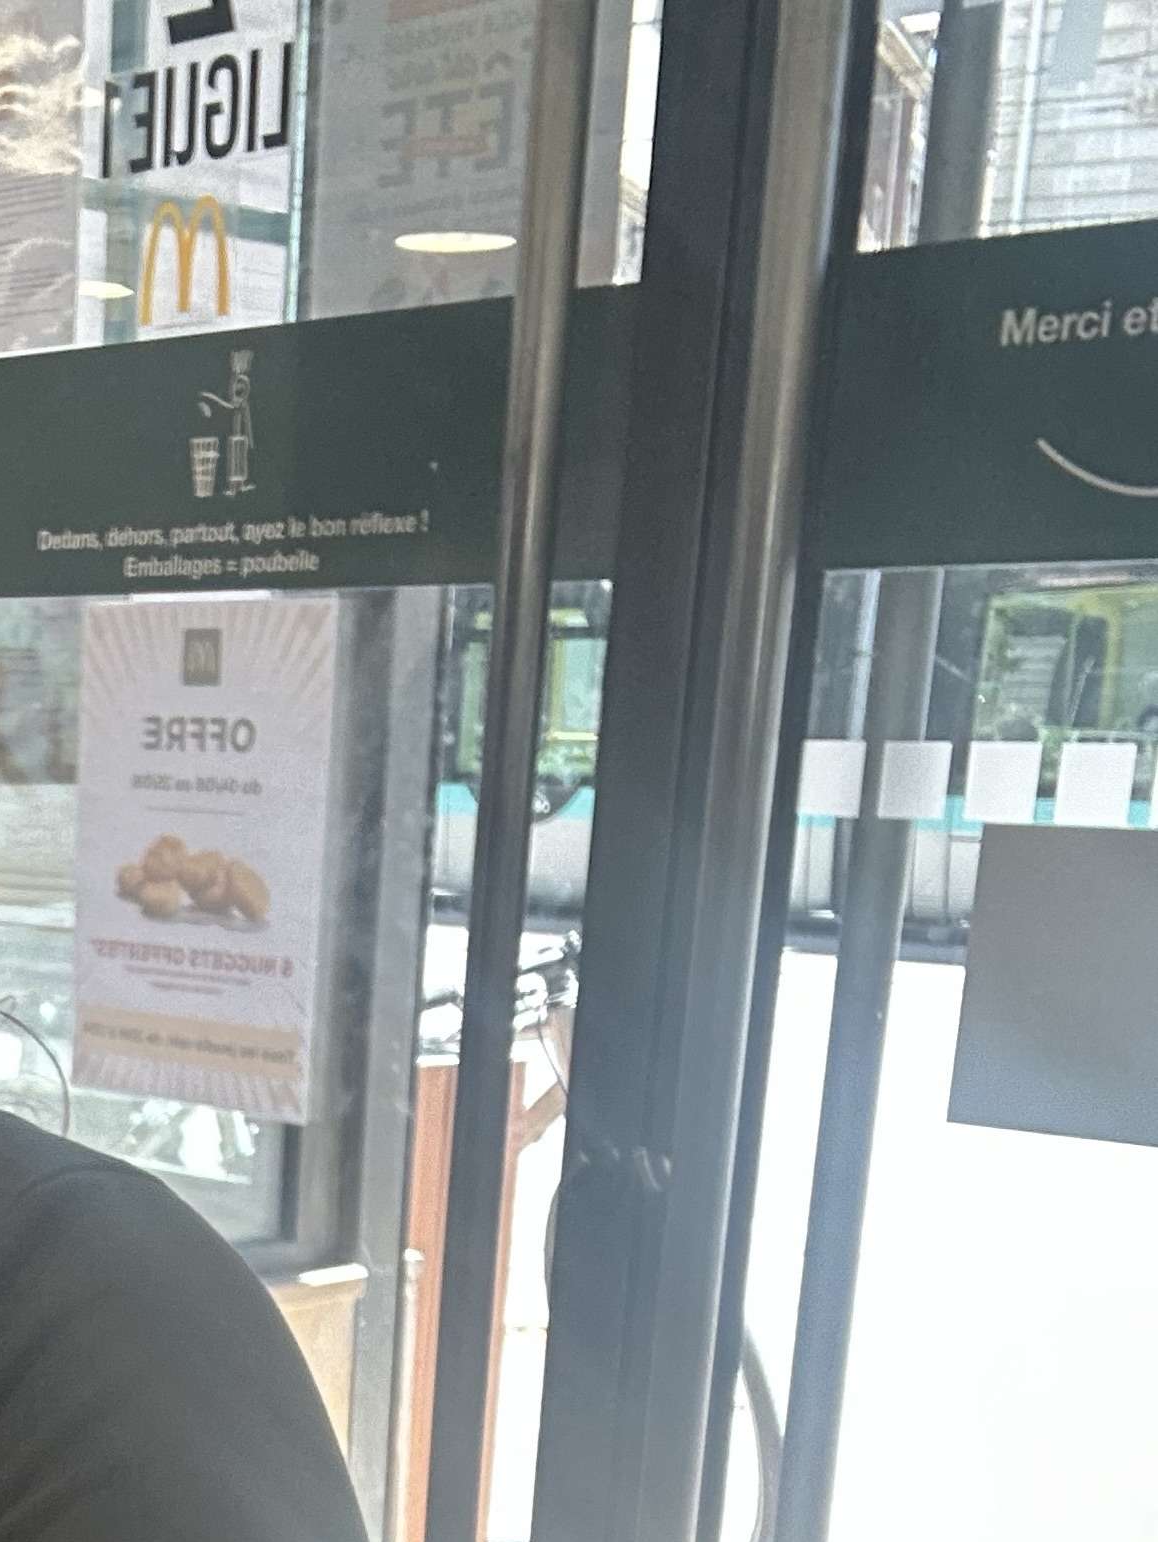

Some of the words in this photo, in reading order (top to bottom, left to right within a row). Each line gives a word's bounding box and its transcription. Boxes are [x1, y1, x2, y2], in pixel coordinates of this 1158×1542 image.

[1001, 300, 1113, 347] Merci
[37, 530, 102, 552] Dedans,
[105, 526, 168, 549] dehors,
[170, 521, 240, 548] partout,
[242, 522, 285, 545] ayez
[288, 516, 307, 538] le
[309, 514, 346, 537] bon
[123, 555, 222, 580] Emballages
[240, 550, 320, 579] poubelle
